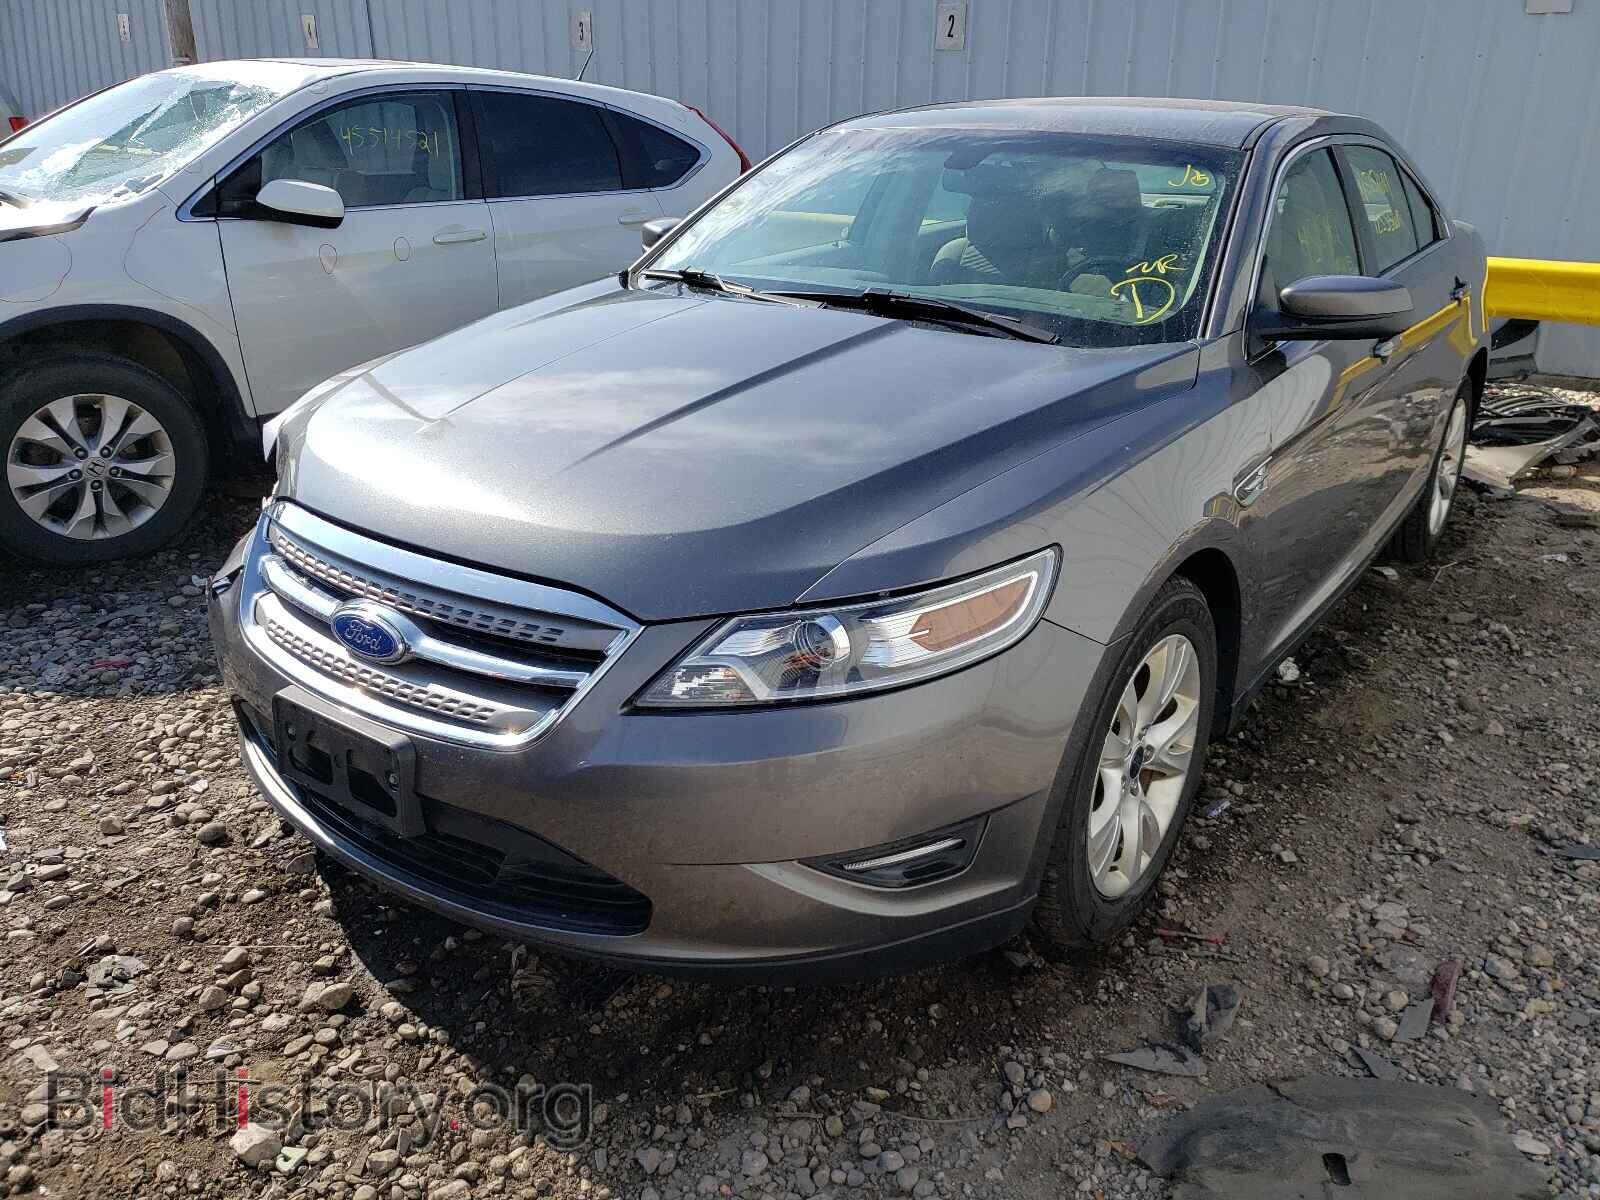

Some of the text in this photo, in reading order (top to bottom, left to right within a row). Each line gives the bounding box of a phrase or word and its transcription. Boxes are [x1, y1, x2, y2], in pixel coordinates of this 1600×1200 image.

[579, 21, 584, 41] 3
[947, 14, 955, 38] 2
[343, 618, 383, 651] Ford
